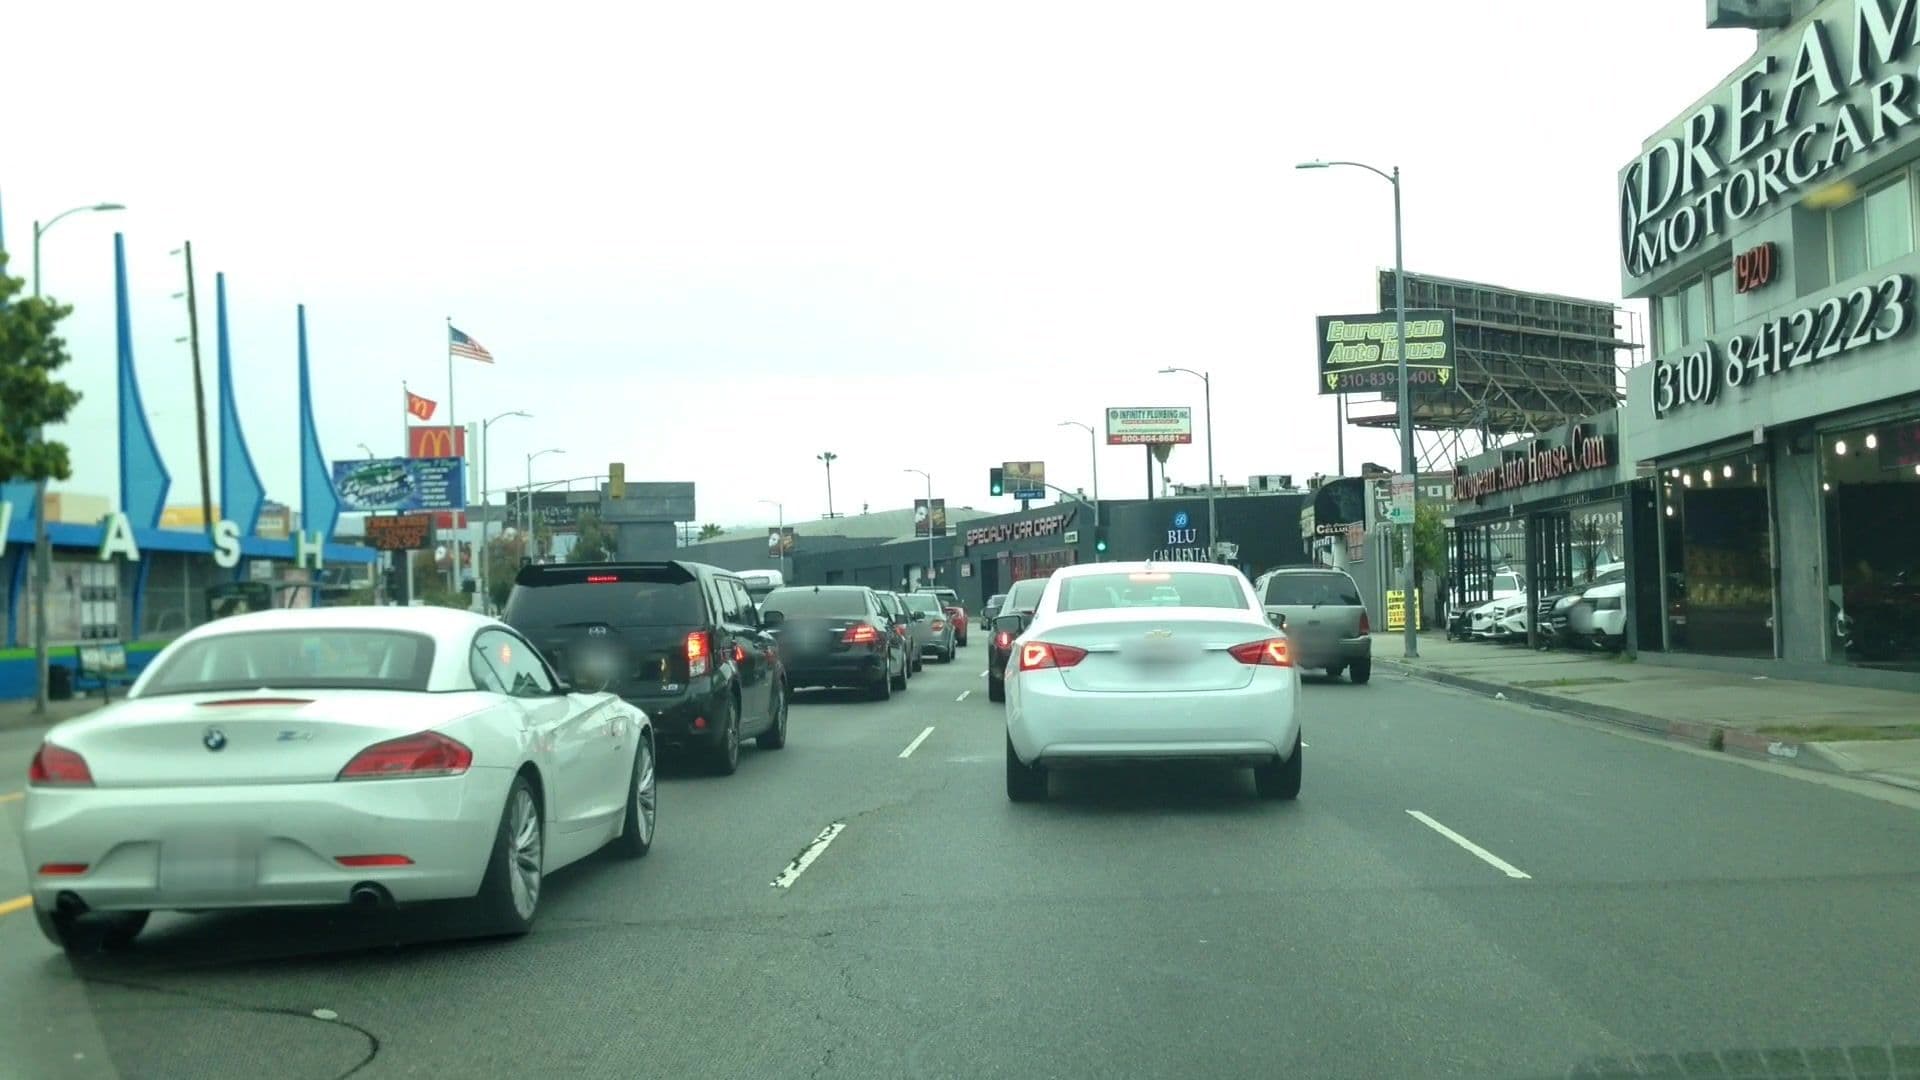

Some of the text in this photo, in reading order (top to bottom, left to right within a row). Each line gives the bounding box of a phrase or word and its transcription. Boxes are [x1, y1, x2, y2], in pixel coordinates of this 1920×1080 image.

[1639, 0, 1920, 224] DREAM
[1638, 67, 1920, 274] MOTORCAR
[1326, 320, 1445, 343] European
[1651, 274, 1905, 418] (310) 841-2223
[1326, 341, 1447, 364] Auto Huse
[1340, 370, 1437, 388] 310-839-400
[1499, 450, 1526, 491] Auto
[967, 514, 1064, 546] SPECIALTY CAR CRAFT
[1168, 529, 1197, 544] BLU
